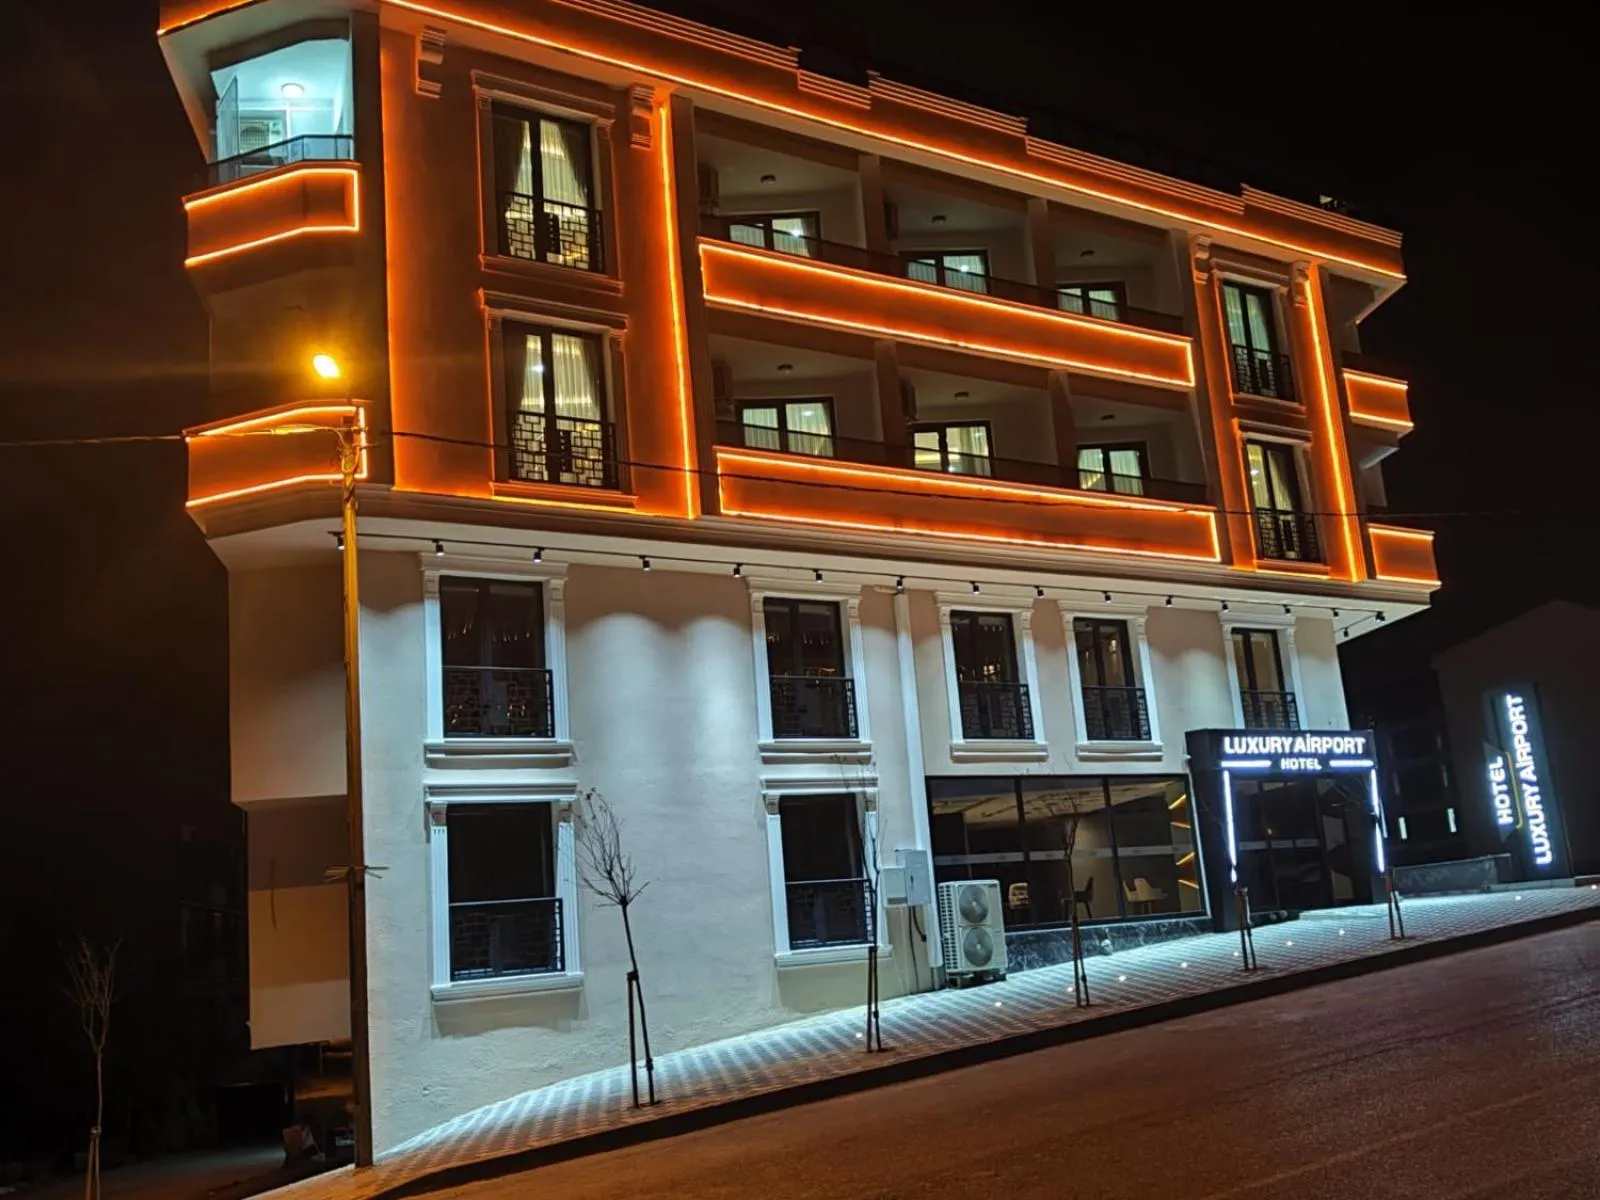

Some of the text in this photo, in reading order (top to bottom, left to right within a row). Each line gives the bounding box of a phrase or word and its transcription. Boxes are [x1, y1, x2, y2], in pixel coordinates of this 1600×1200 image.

[1223, 736, 1293, 754] LUXURY
[1280, 757, 1322, 770] HOTEL
[1488, 755, 1514, 825] HOTEL
[1521, 783, 1552, 865] LUXURY
